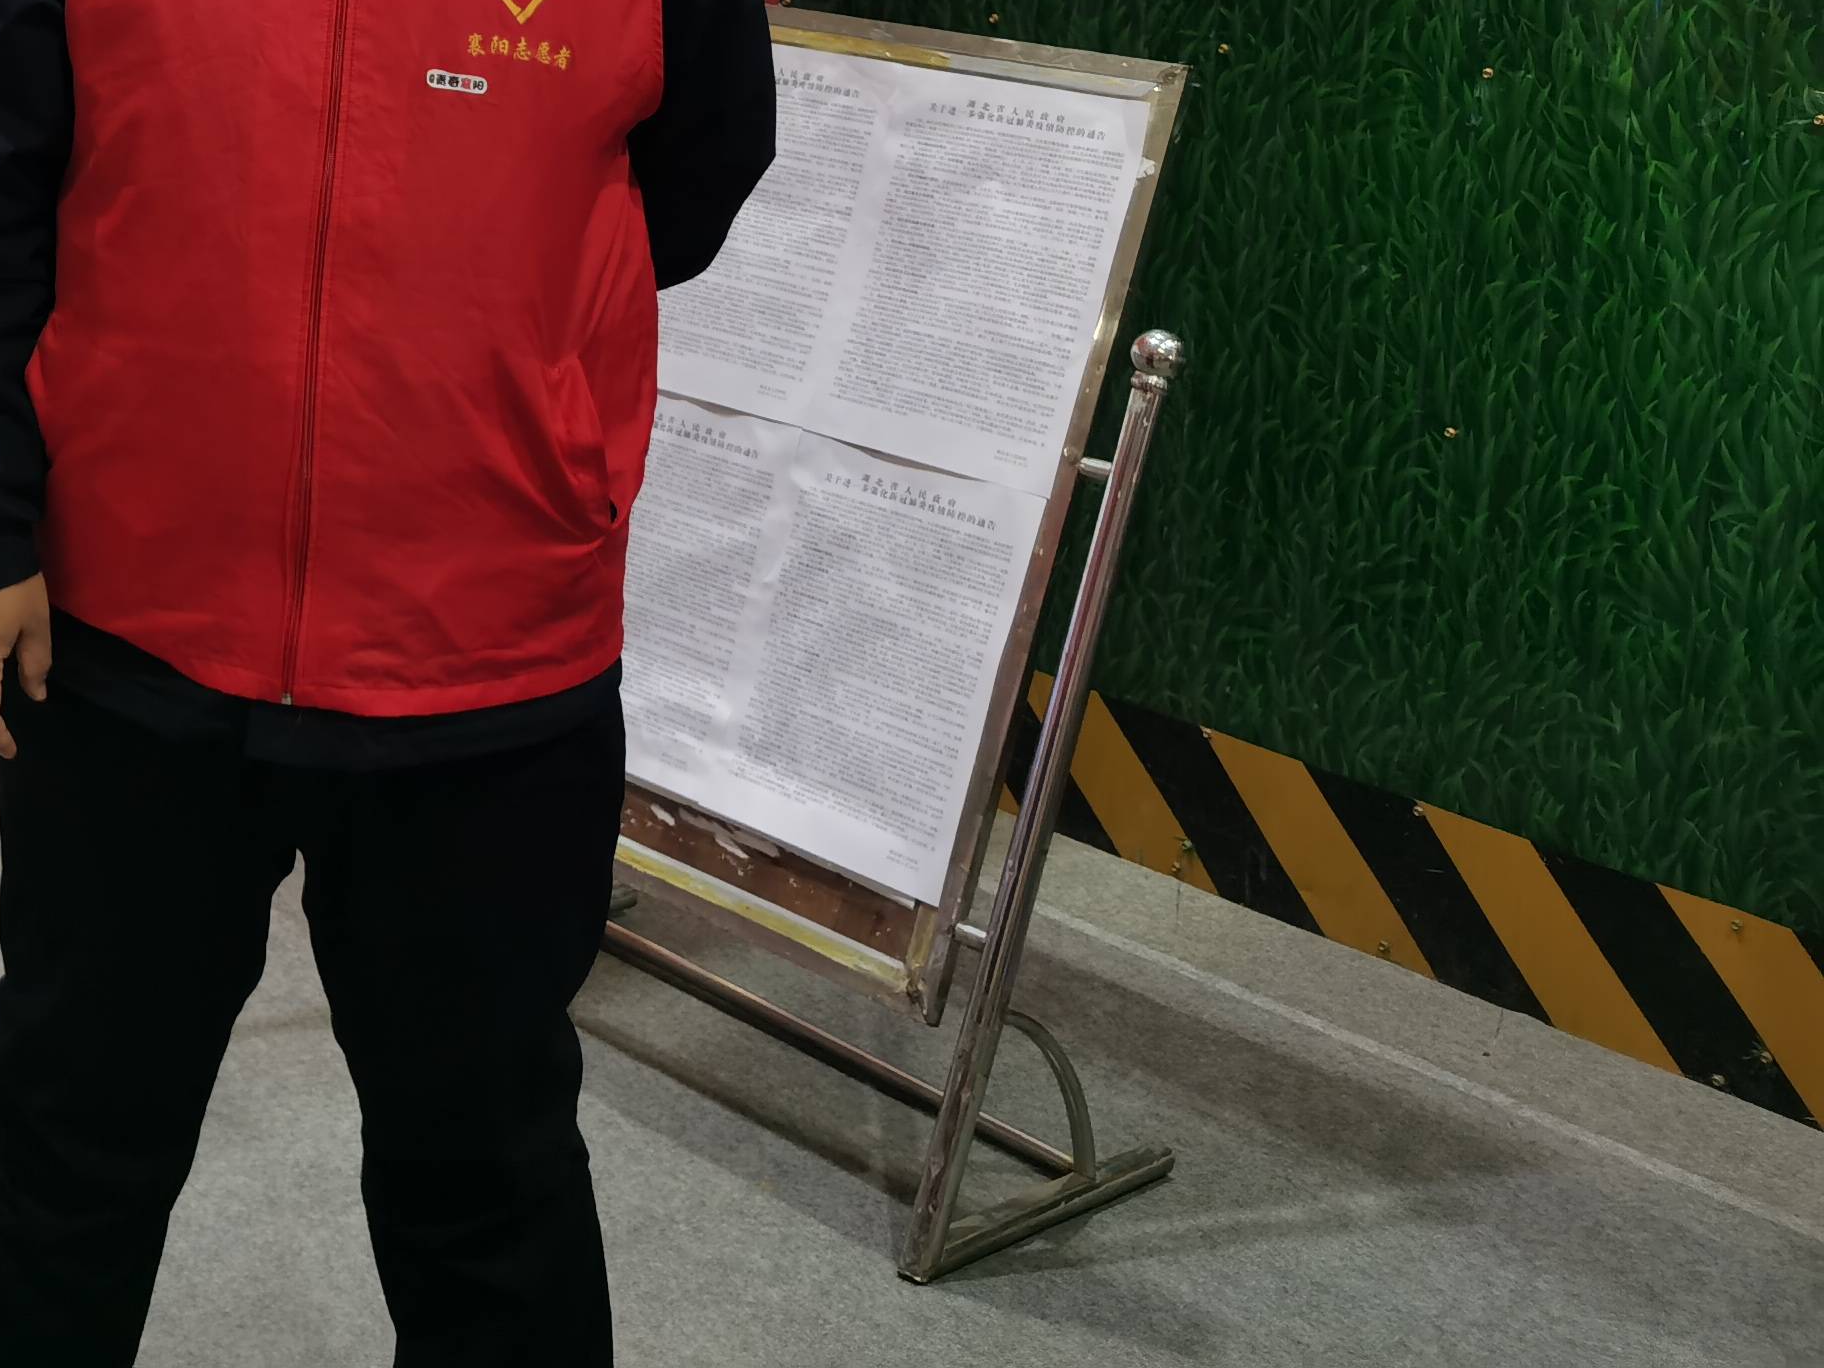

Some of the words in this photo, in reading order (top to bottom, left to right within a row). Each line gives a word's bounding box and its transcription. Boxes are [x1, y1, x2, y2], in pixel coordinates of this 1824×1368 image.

[467, 32, 572, 71] 襄阳志愿者
